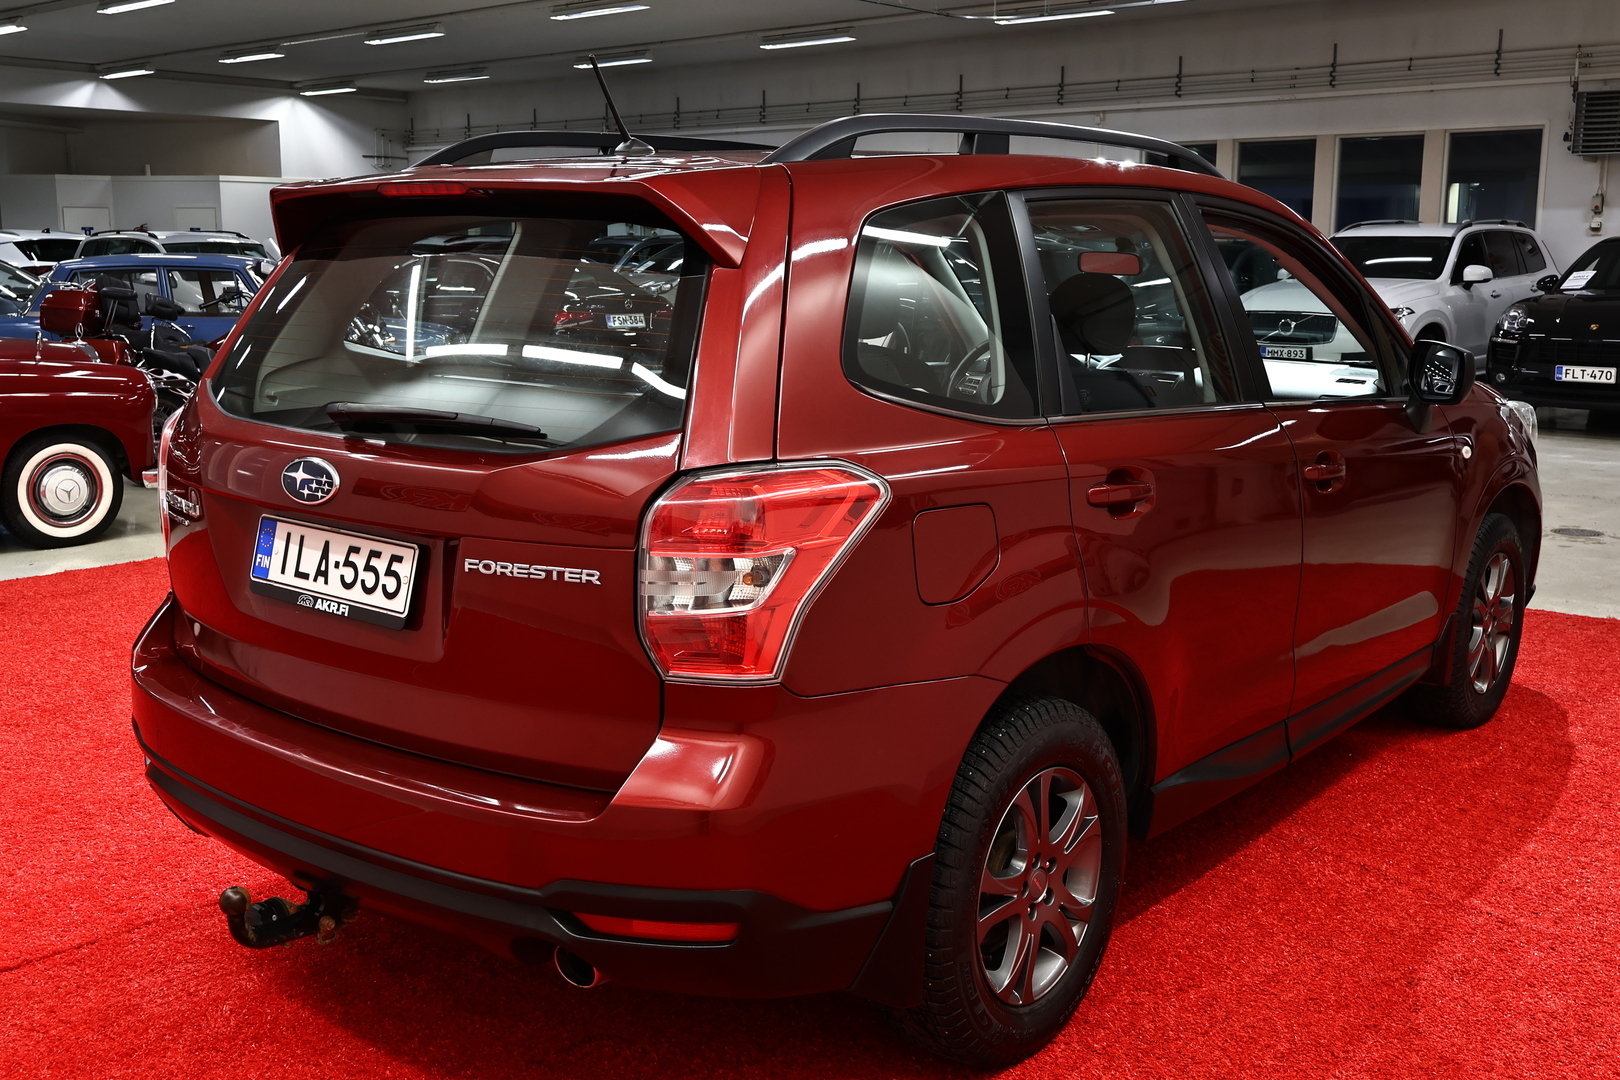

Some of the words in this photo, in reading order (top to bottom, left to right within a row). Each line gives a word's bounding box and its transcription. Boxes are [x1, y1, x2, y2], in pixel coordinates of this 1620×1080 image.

[1565, 368, 1612, 381] FLT-470
[255, 553, 271, 569] FIN
[280, 531, 405, 600] ILA-555
[464, 558, 601, 585] FORESTER
[314, 598, 349, 617] AKR.FI
